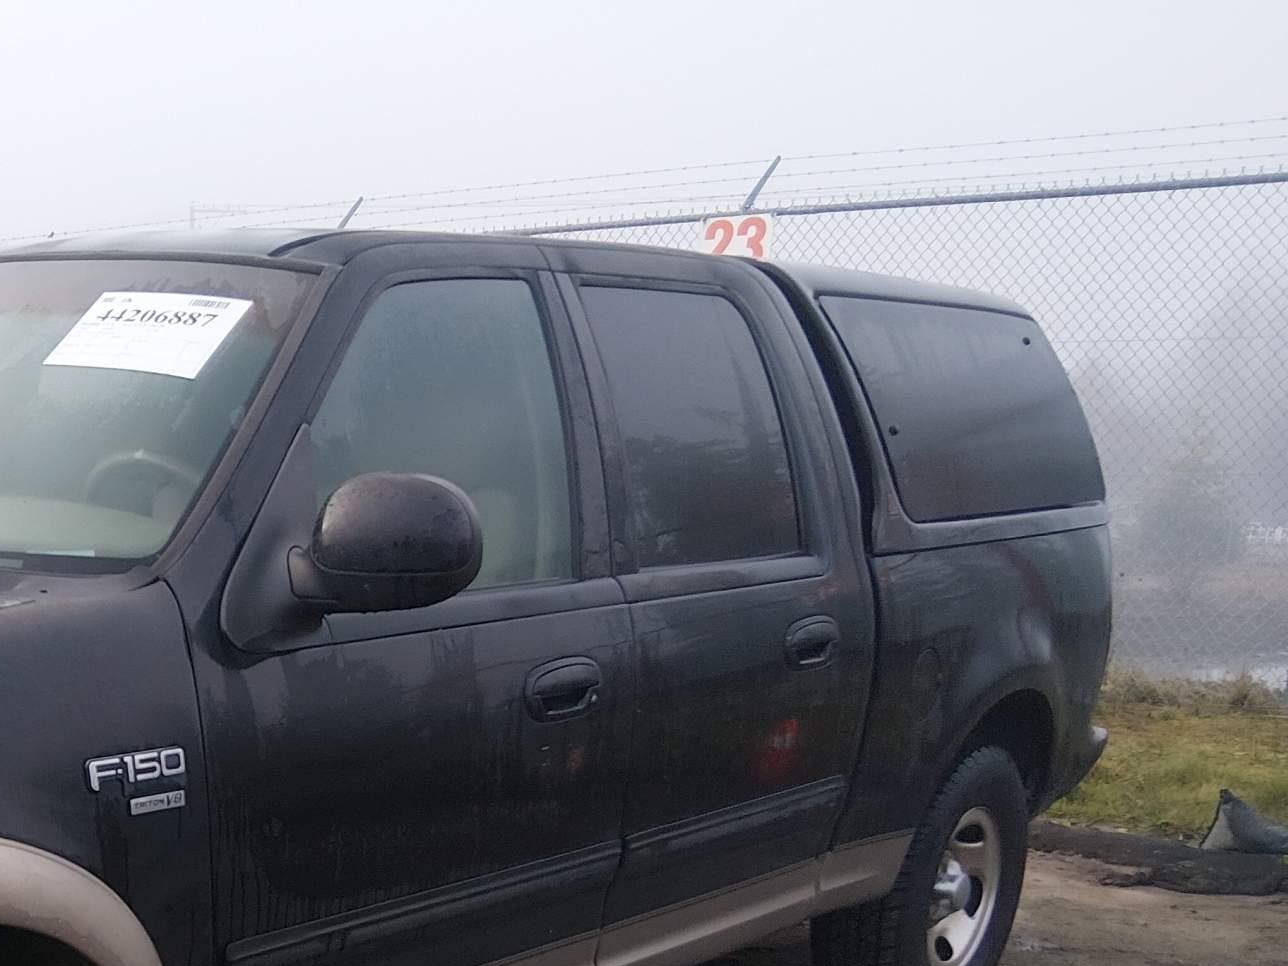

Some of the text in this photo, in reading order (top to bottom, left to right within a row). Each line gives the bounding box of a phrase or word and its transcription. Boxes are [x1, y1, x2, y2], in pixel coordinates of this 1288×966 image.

[704, 217, 767, 258] 23
[97, 308, 220, 328] 44206887
[166, 792, 183, 808] V8
